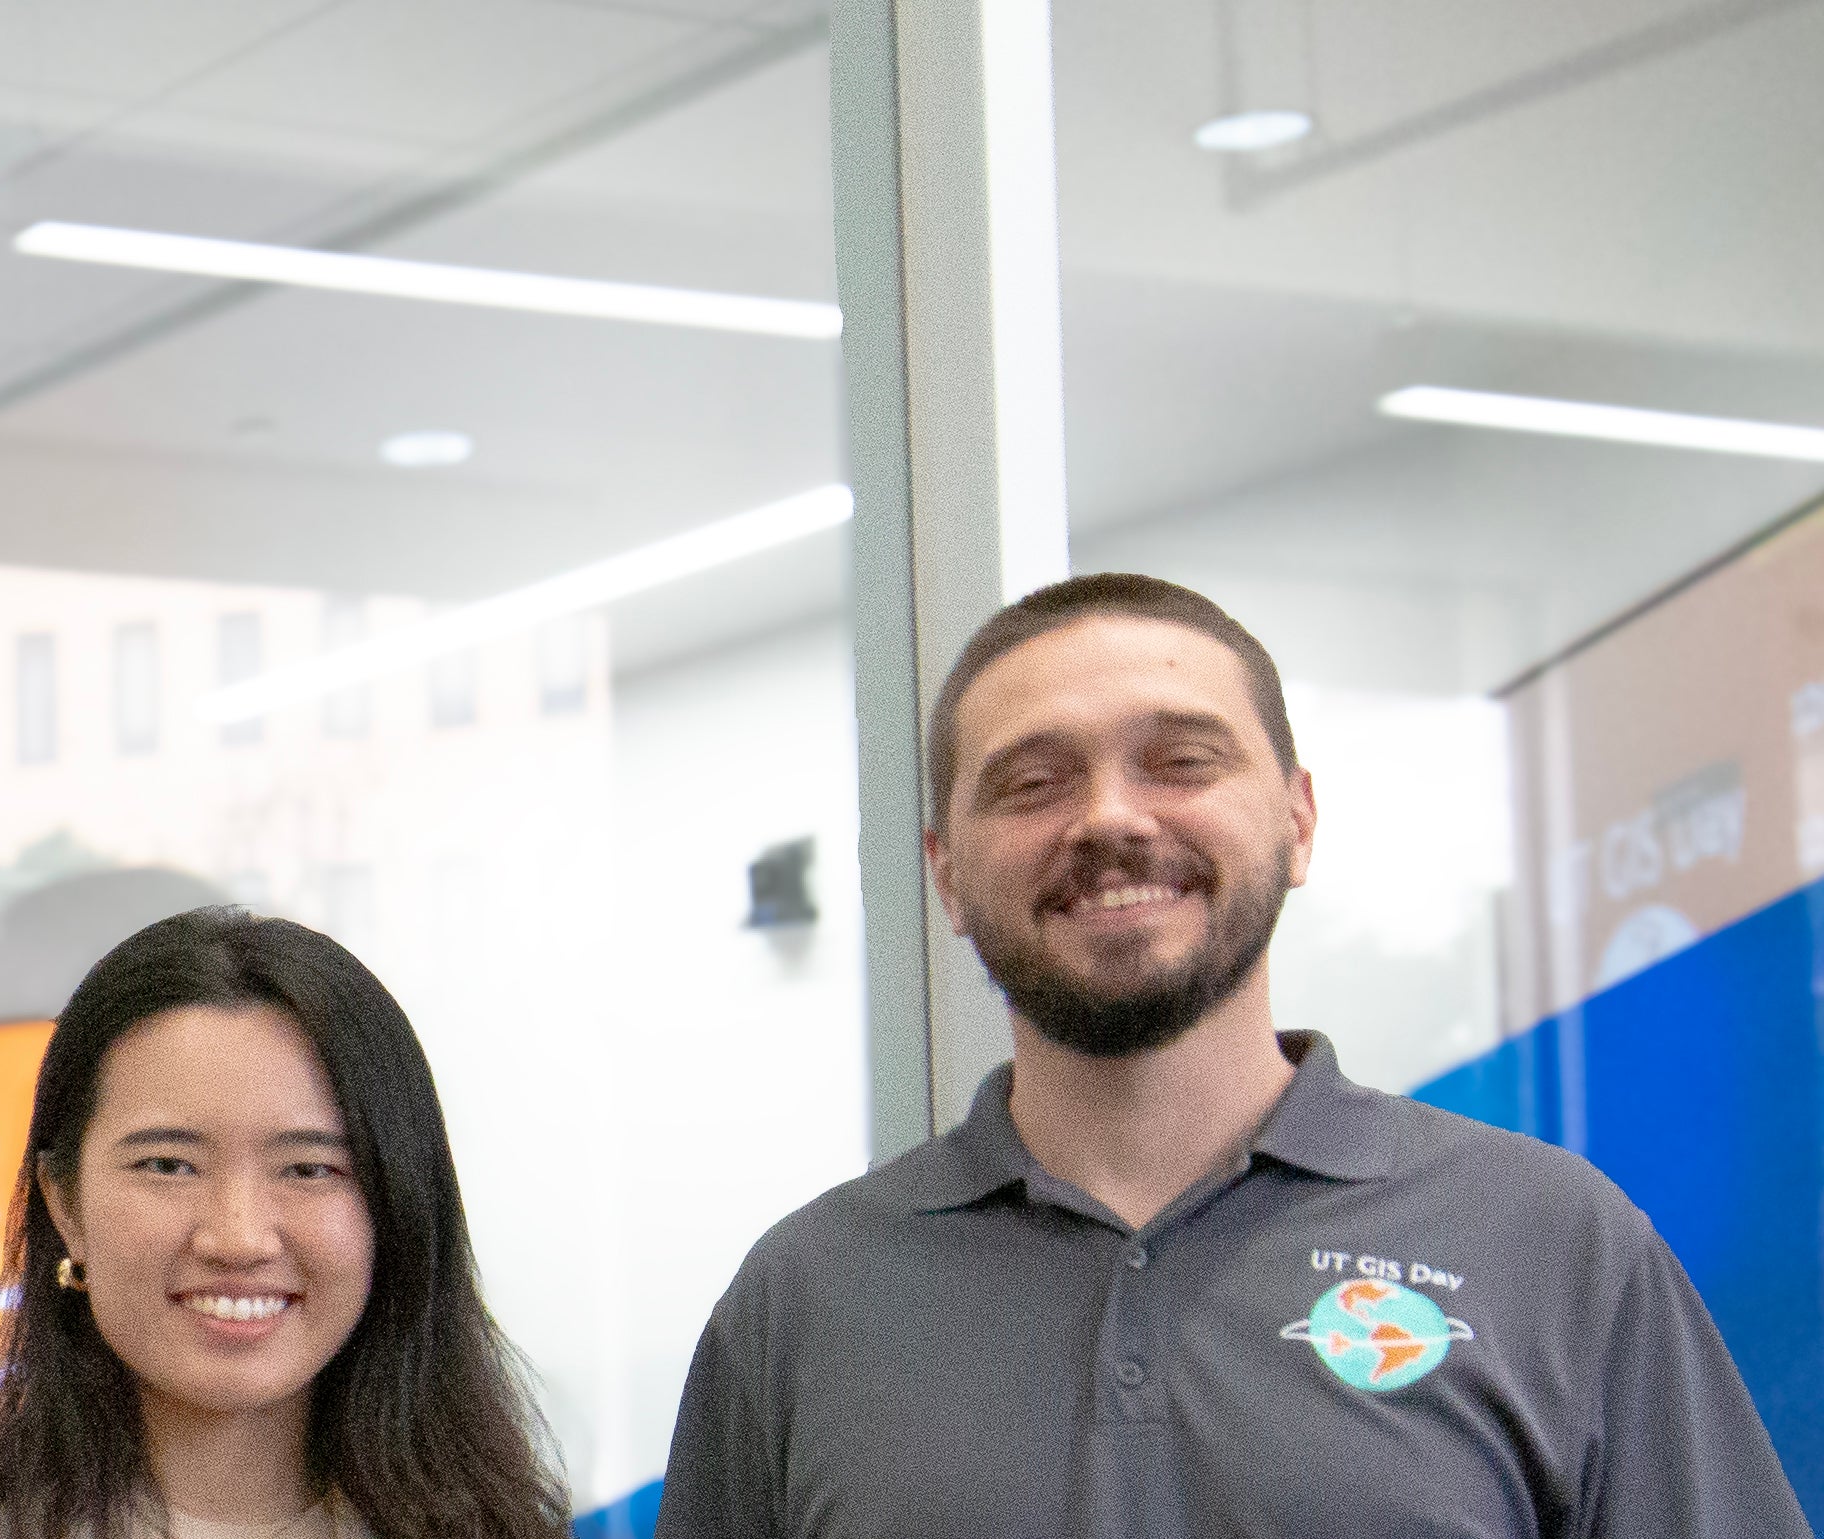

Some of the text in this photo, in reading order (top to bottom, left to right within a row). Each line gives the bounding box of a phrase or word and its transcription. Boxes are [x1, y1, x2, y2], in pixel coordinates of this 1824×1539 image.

[1310, 1249, 1465, 1292] UT GIS Day
